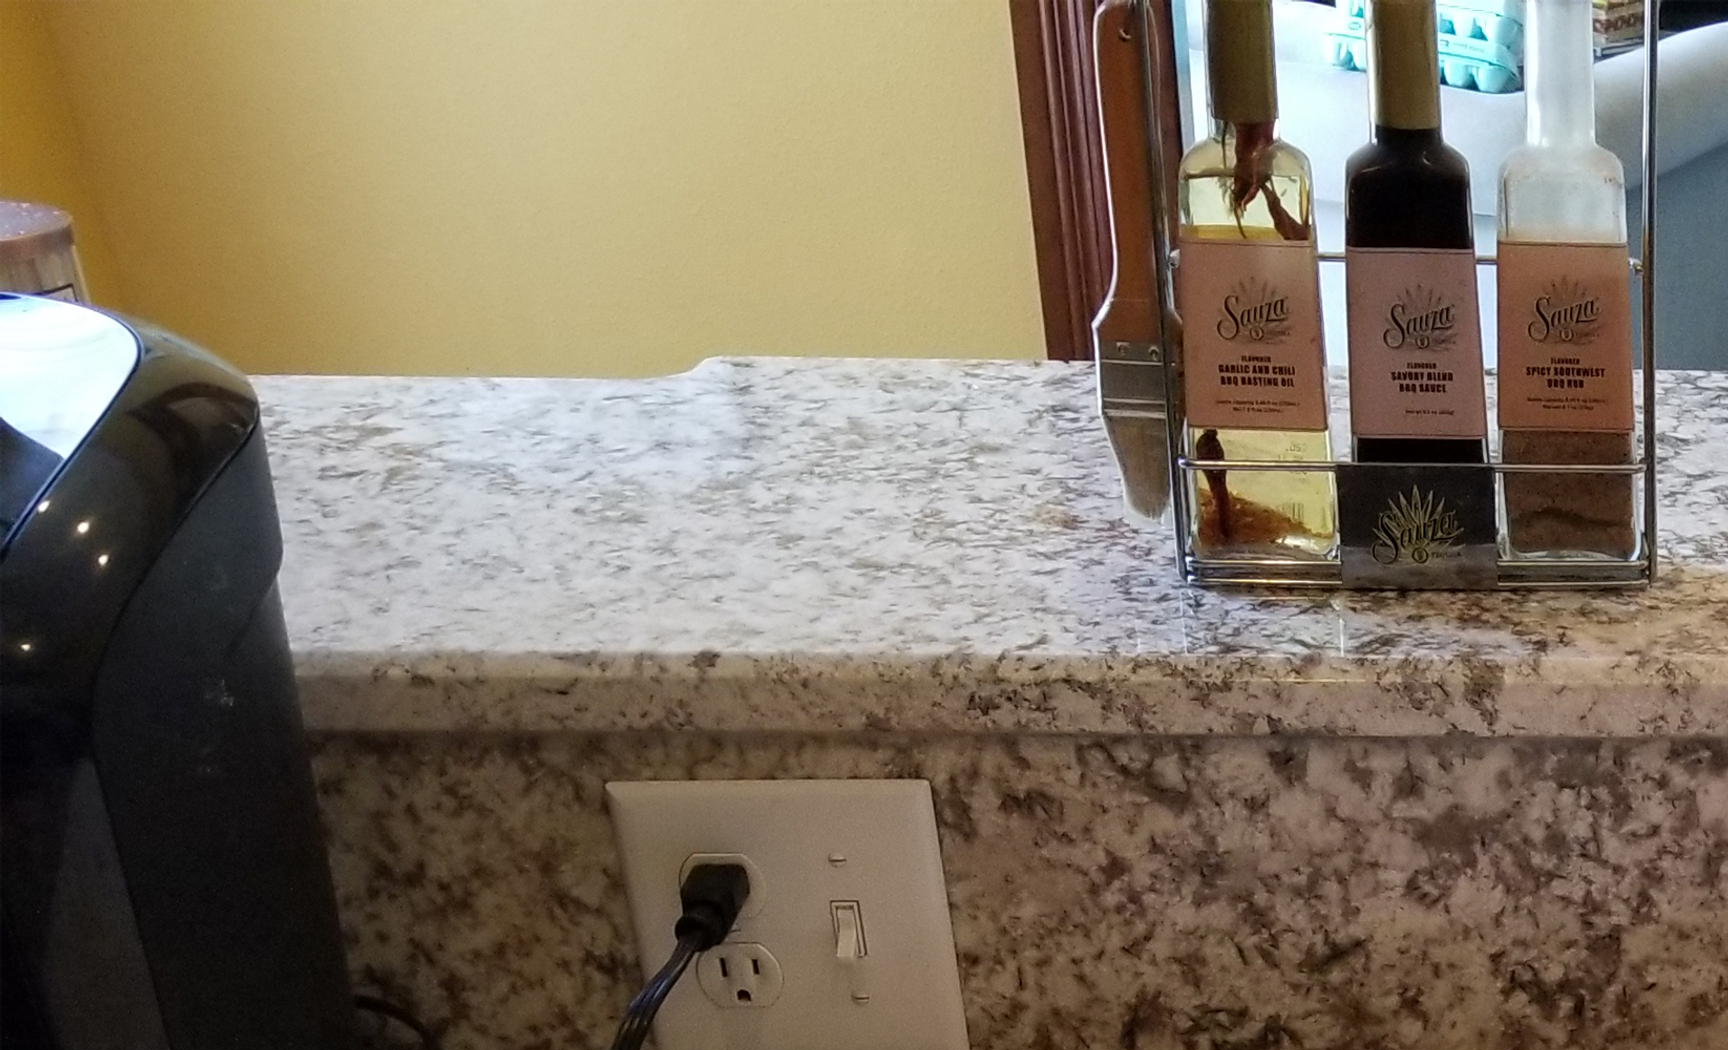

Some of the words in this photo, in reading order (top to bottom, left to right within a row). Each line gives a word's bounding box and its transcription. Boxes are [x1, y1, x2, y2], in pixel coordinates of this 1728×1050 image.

[1216, 294, 1291, 341] Sauza
[1527, 296, 1601, 342] Sauza
[1382, 303, 1456, 349] Sauza
[1218, 364, 1251, 374] GARLIC
[1252, 365, 1270, 375] AND
[1272, 366, 1296, 376] CHILI
[1526, 366, 1552, 376] SPICY
[1553, 367, 1606, 378] SOUTHWEST
[1220, 375, 1239, 387] BBQ
[1240, 376, 1279, 387] BASTING
[1281, 377, 1295, 388] OIL
[1390, 371, 1425, 381] SAVORY
[1426, 371, 1454, 382] BLEND
[1399, 383, 1417, 394] BBQ
[1418, 383, 1448, 393] SAUCE
[1546, 378, 1565, 389] BBQ
[1371, 509, 1460, 566] Sauza
